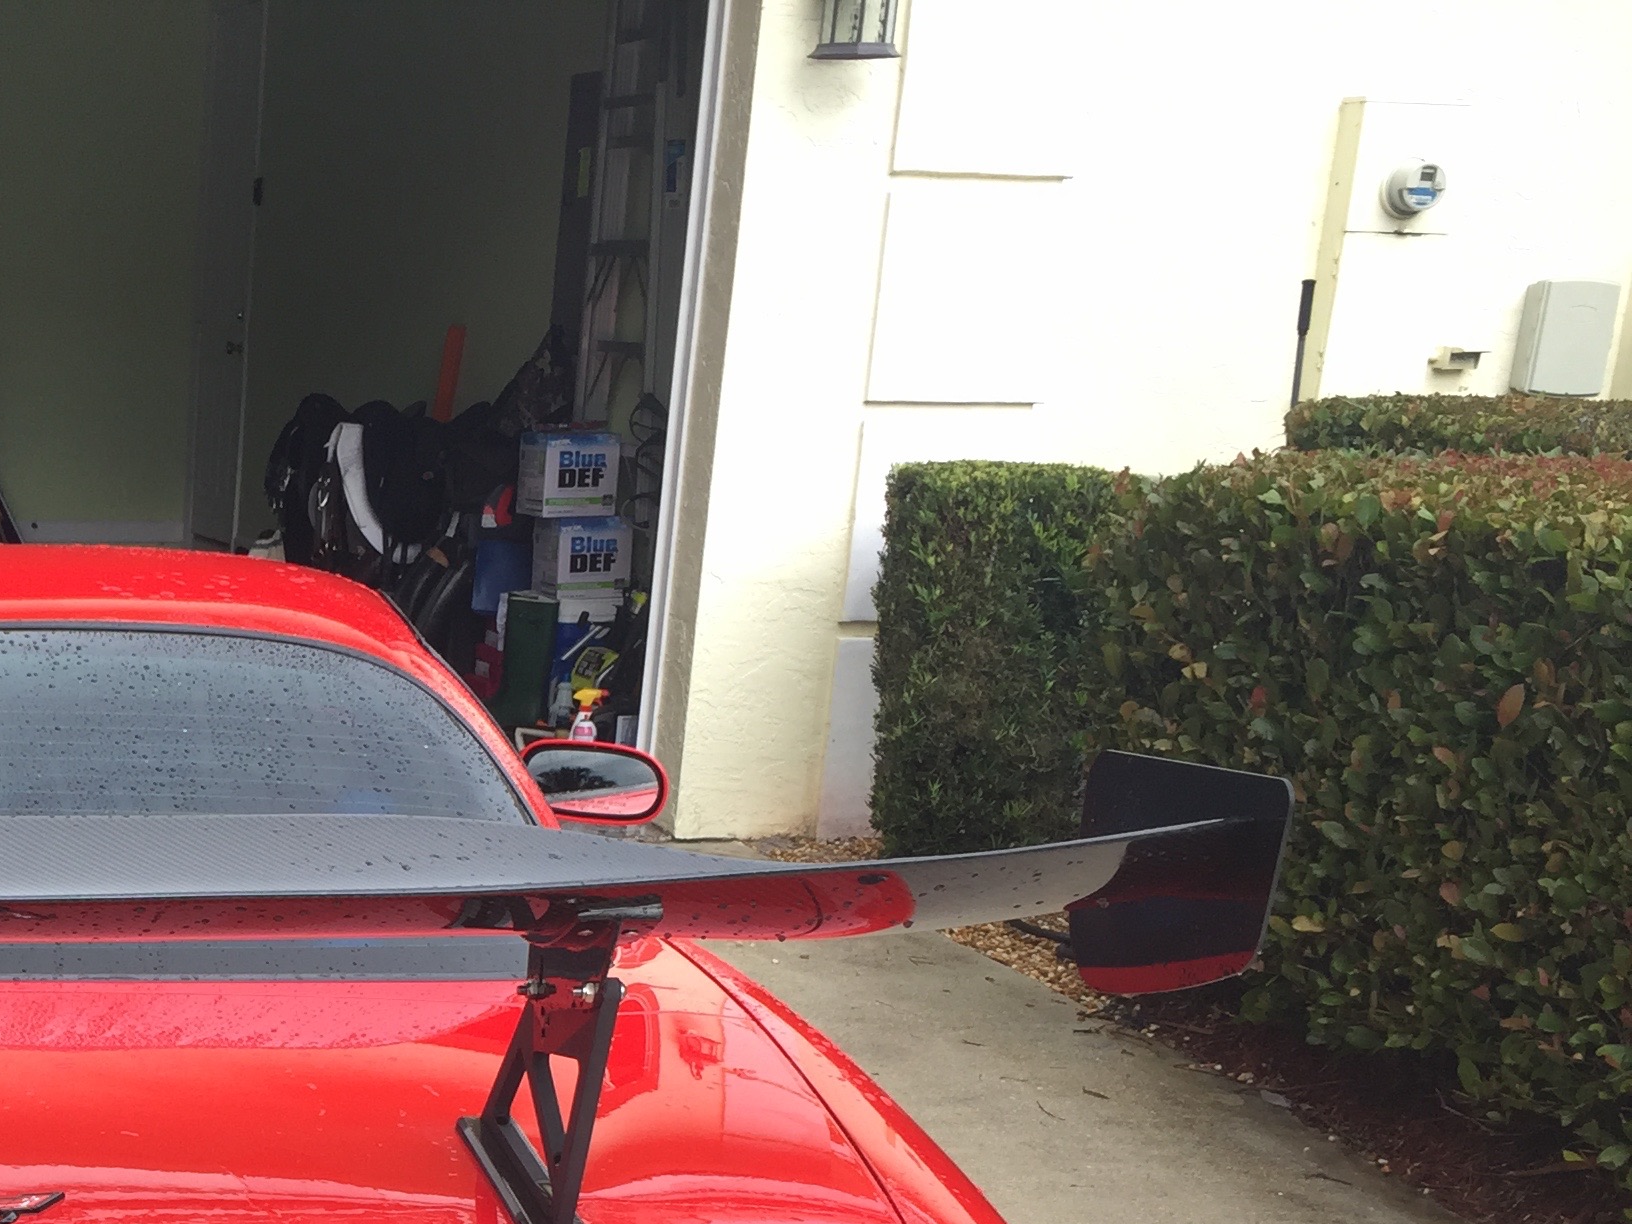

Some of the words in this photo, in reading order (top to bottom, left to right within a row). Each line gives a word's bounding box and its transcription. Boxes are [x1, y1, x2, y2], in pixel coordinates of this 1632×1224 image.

[558, 450, 607, 469] Blue
[557, 467, 605, 488] DEF
[570, 536, 619, 554] Blue
[569, 553, 616, 573] DEF
